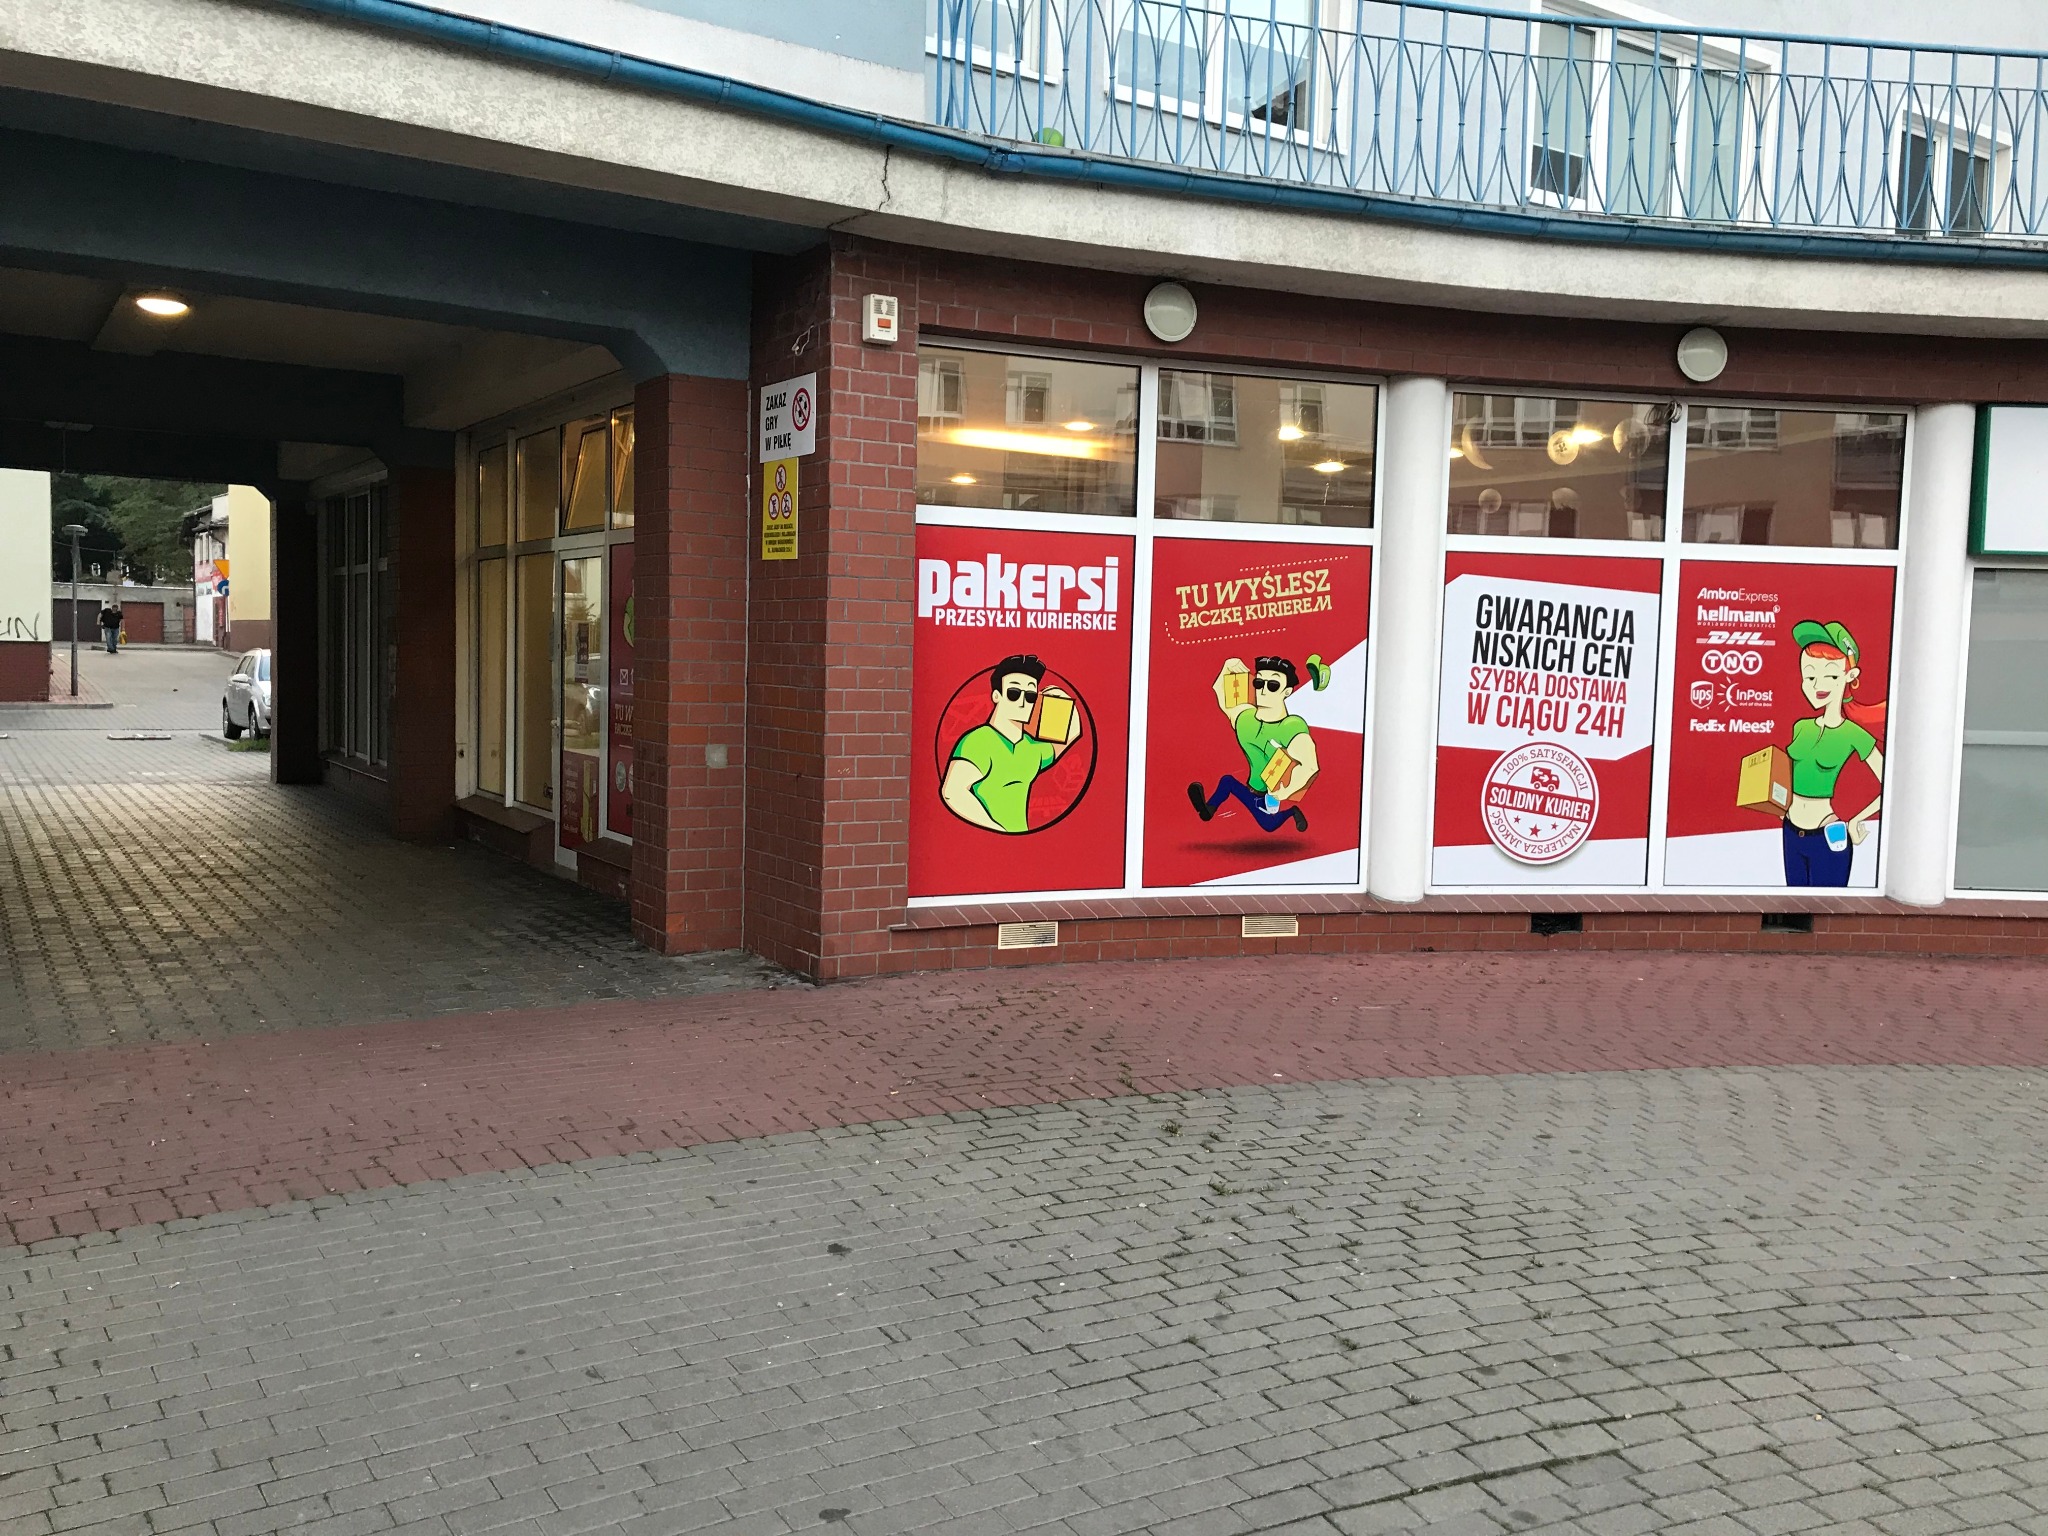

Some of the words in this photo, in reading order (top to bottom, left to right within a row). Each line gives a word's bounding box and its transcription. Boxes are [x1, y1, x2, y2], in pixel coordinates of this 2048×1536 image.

[766, 392, 787, 411] ZAKAZ
[765, 415, 779, 431] GRY
[765, 436, 772, 451] W
[773, 433, 791, 450] PIŁKĘ
[918, 553, 1119, 618] pakersi
[1176, 584, 1209, 610] TU
[1214, 569, 1331, 605] WYŚLESZ
[1697, 587, 1779, 603] AmbroExpress
[935, 608, 1021, 628] PRZESYŁKI
[1026, 611, 1117, 630] KURIERSKIE
[1179, 607, 1244, 629] PACZKĘ
[1245, 595, 1332, 621] KURIEREM
[1476, 594, 1635, 645] GWARANCJA
[1697, 605, 1776, 623] hellmann
[1706, 630, 1766, 646] DHL
[1472, 630, 1576, 673] NISKICH
[1582, 643, 1633, 679] CEN
[1706, 654, 1758, 670] TNT
[1469, 666, 1540, 696] SZYBKA
[1544, 674, 1627, 704] DOSTAWA
[1736, 689, 1773, 701] InPost
[1467, 692, 1491, 725] W
[1496, 695, 1570, 736] CIĄGU
[1575, 703, 1626, 738] 24H
[1689, 719, 1726, 732] FedEx
[1729, 719, 1773, 733] Meest
[1502, 753, 1529, 776] 100%
[1529, 748, 1588, 790] SATYSFAKCJI
[1489, 786, 1544, 812] SOLIDNY
[1545, 796, 1591, 821] KURIER
[1490, 810, 1522, 848] JAKOŚĆ
[1524, 824, 1581, 854] NAJLEPSZA
